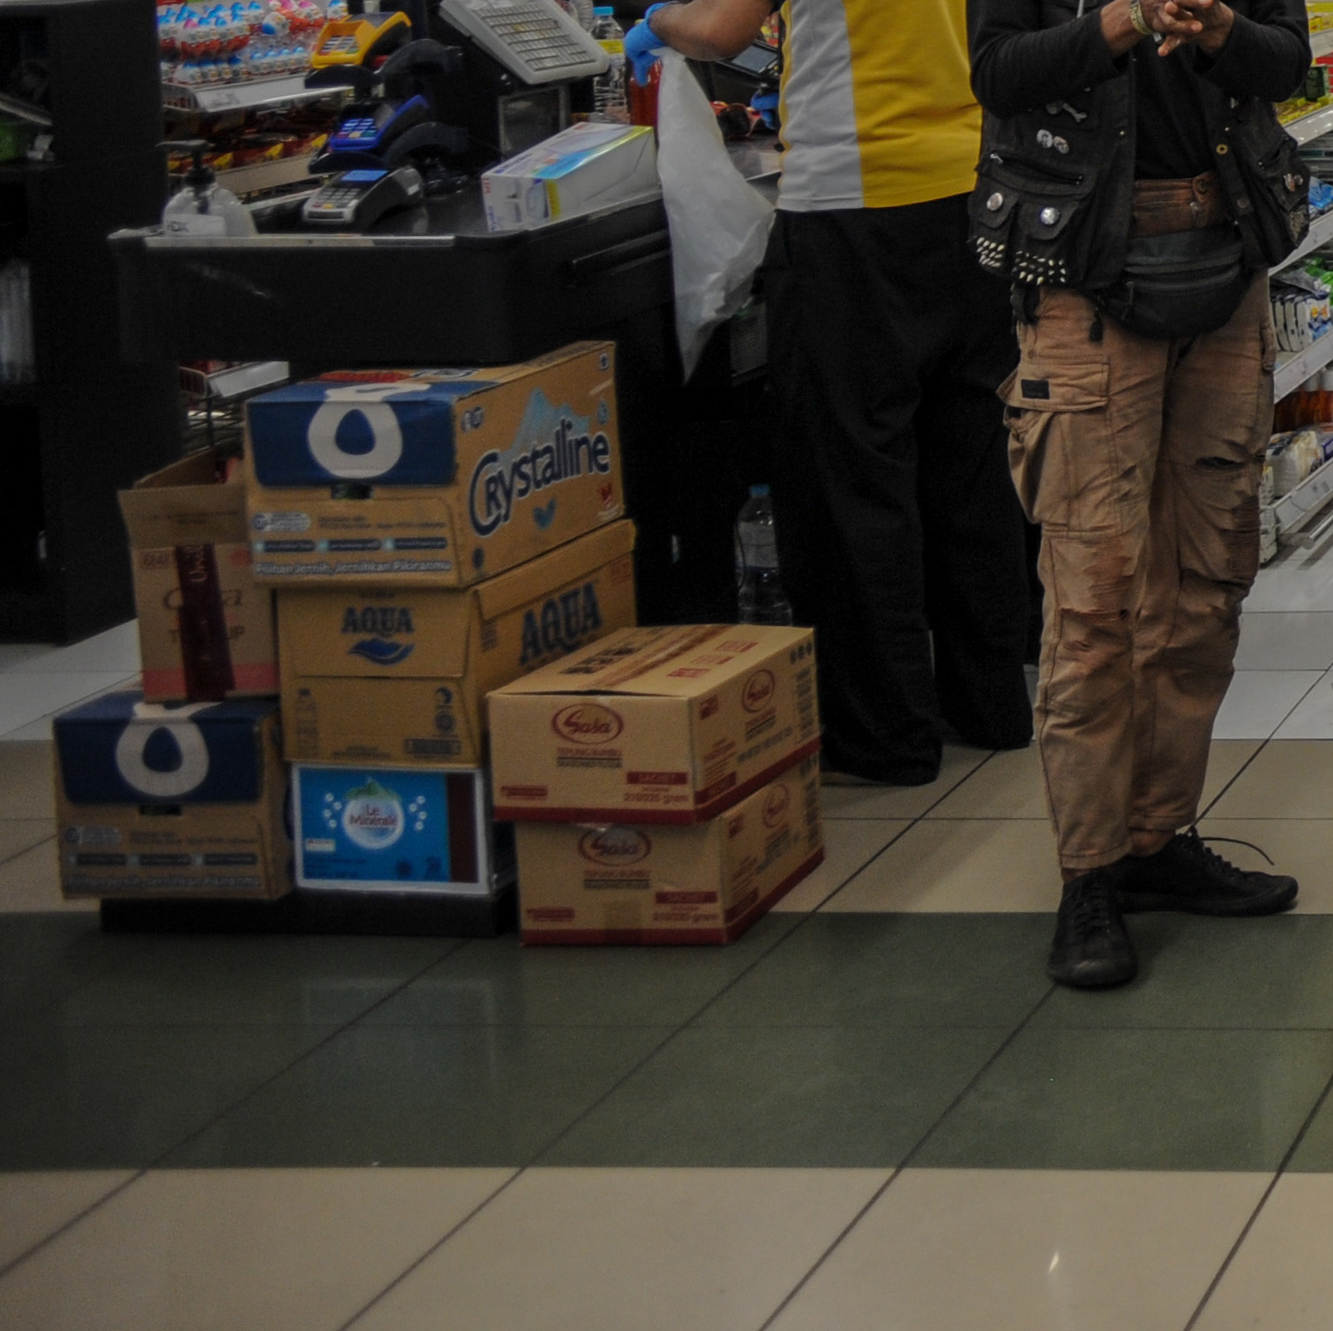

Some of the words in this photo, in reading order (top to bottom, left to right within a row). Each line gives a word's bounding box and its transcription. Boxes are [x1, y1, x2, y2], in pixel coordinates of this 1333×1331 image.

[469, 418, 611, 536] Crystalline
[255, 562, 292, 575] Pilihan
[334, 561, 392, 575] Jernihkan
[393, 560, 452, 572] Pikiranmu
[342, 608, 414, 638] AQUA
[519, 580, 602, 665] AQUA
[564, 709, 612, 734] Sasa
[350, 812, 398, 826] Minerale
[365, 806, 380, 816] Le
[592, 830, 642, 857] Sasa
